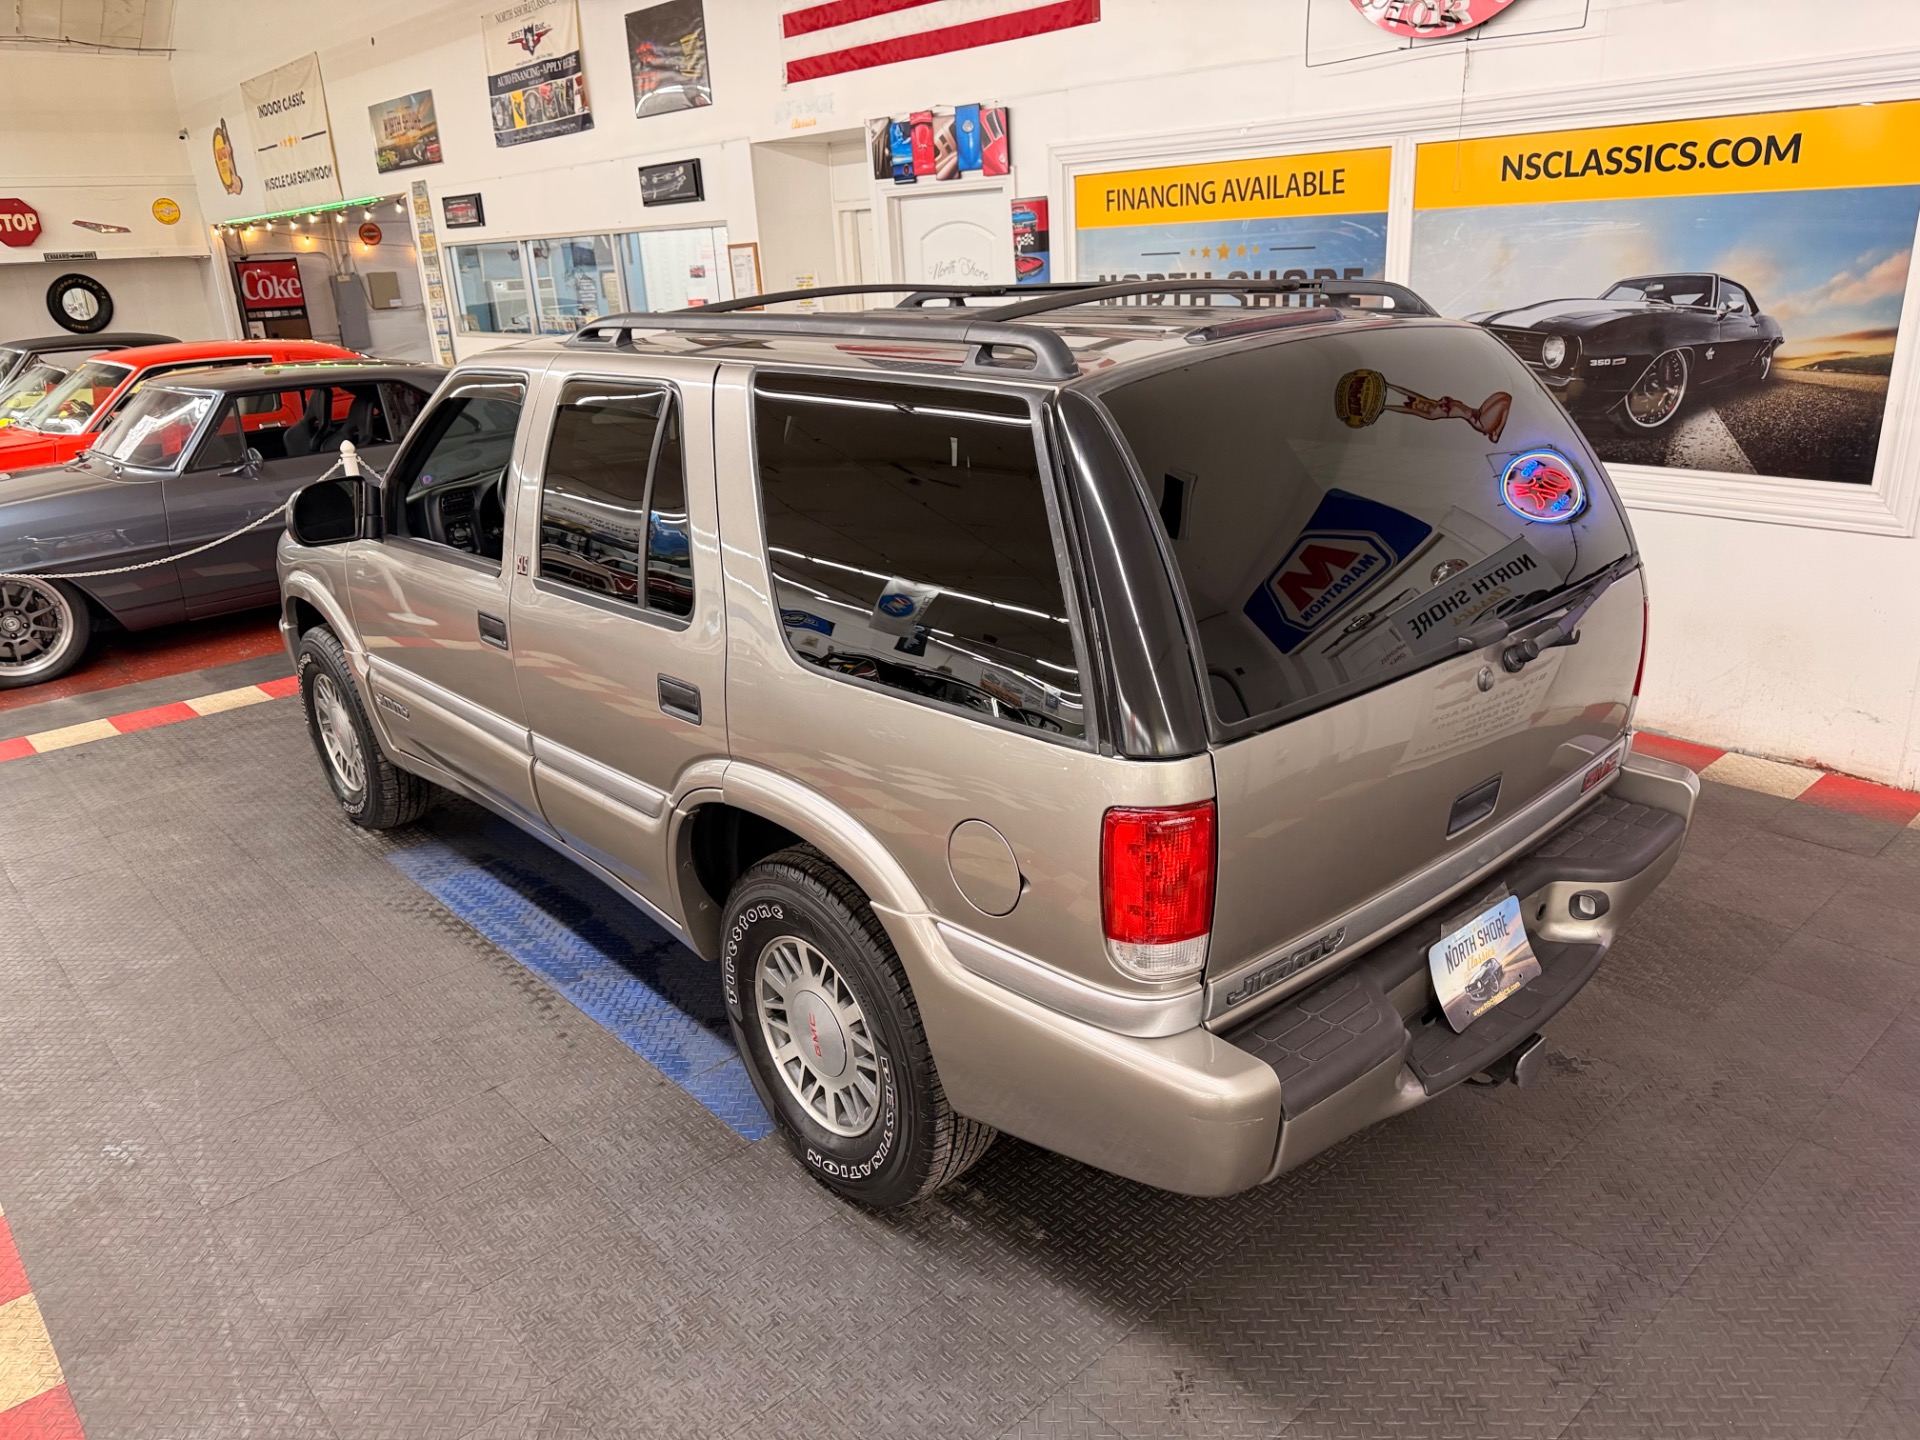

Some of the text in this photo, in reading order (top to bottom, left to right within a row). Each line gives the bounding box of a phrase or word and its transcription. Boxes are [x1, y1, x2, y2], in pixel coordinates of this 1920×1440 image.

[257, 100, 282, 118] INDOOR
[264, 164, 334, 192] MUSCLE CAR SHOWROOM
[1501, 133, 1803, 182] NSCLASSICS.COM
[1105, 168, 1346, 212] FINANCING AVAILABLE
[242, 270, 303, 300] Coke
[1590, 359, 1611, 367] 350
[724, 902, 784, 1006] Firestone
[1445, 914, 1510, 975] NORTH SHORE
[1466, 947, 1497, 971] Classics
[809, 1012, 822, 1058] GMC
[808, 1055, 897, 1179] DESTINATION
